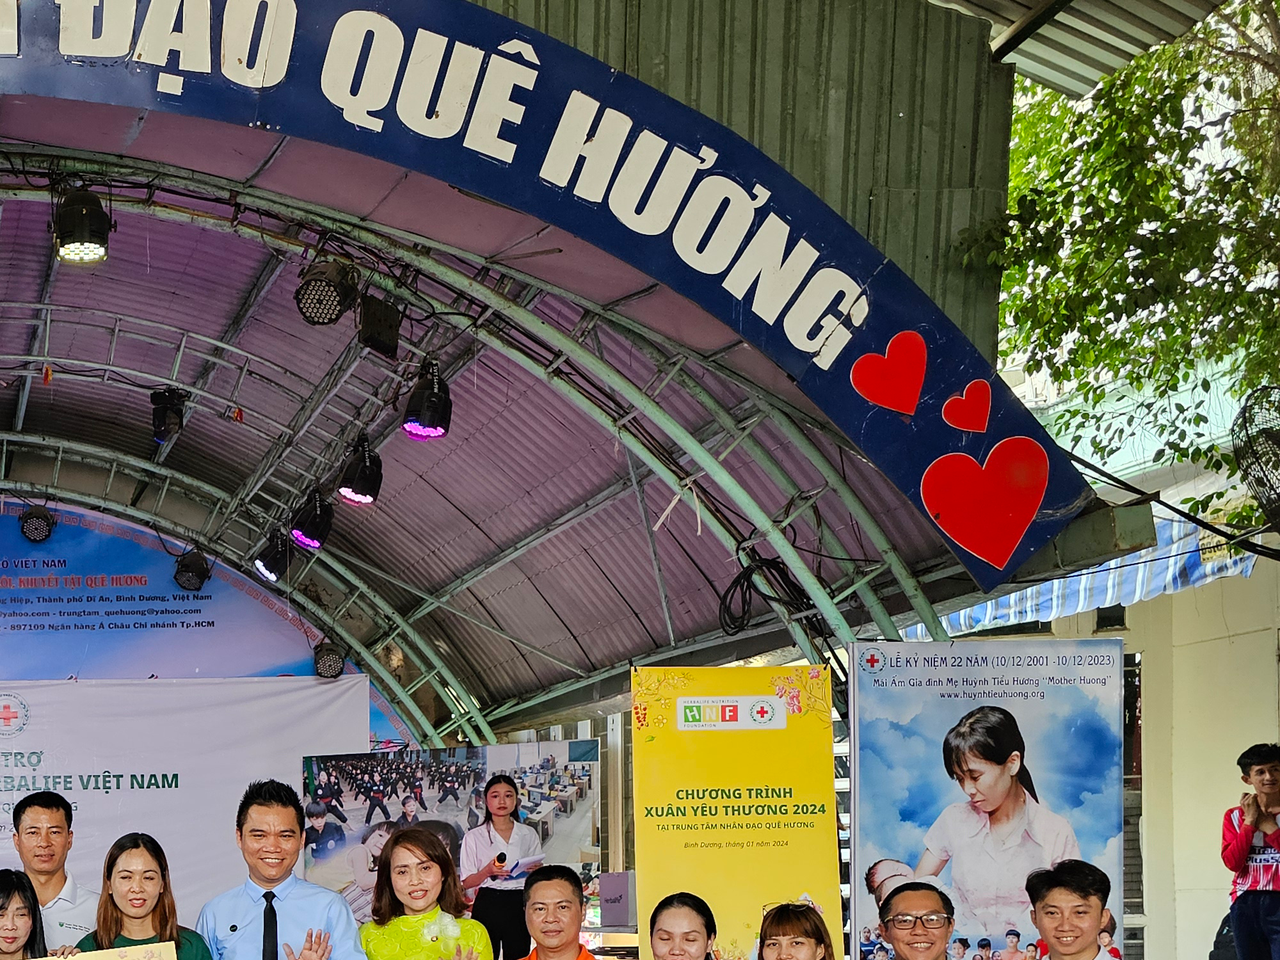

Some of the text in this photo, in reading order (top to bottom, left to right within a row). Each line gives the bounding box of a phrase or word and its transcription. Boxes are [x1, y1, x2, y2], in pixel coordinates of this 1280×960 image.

[56, 0, 295, 95] ĐẠO
[321, 10, 540, 163] QUÊ
[539, 90, 870, 371] HƯƠNG
[13, 558, 38, 570] VIỆT
[42, 559, 67, 569] NAM
[110, 574, 148, 587] HƯƠNG
[192, 593, 212, 602] Nam
[10, 622, 45, 632] 897109
[180, 619, 215, 630] Tp.HCM
[889, 651, 902, 668] LỄ
[923, 653, 948, 670] NIỆM
[950, 656, 963, 668] 22
[991, 655, 1049, 669] (10/12/2001
[1052, 654, 1115, 668] -10/12/2023)
[908, 677, 923, 688] Gia
[946, 677, 959, 689] Mẹ
[962, 675, 989, 689] Huỳnh
[1012, 676, 1040, 688] Hương
[939, 689, 1045, 701] www.huynhtieuhuong.org
[1, 750, 44, 772] TRỢ
[78, 770, 124, 795] VIỆT
[130, 773, 179, 790] NAM
[675, 785, 793, 801] CHƯƠNG TRÌNH
[644, 803, 827, 818] XUÂN YÊU THƯƠNG 2024
[656, 821, 815, 832] TẠI TRUNG TÂM NHÂN ĐẠO QUÊ HƯƠNG
